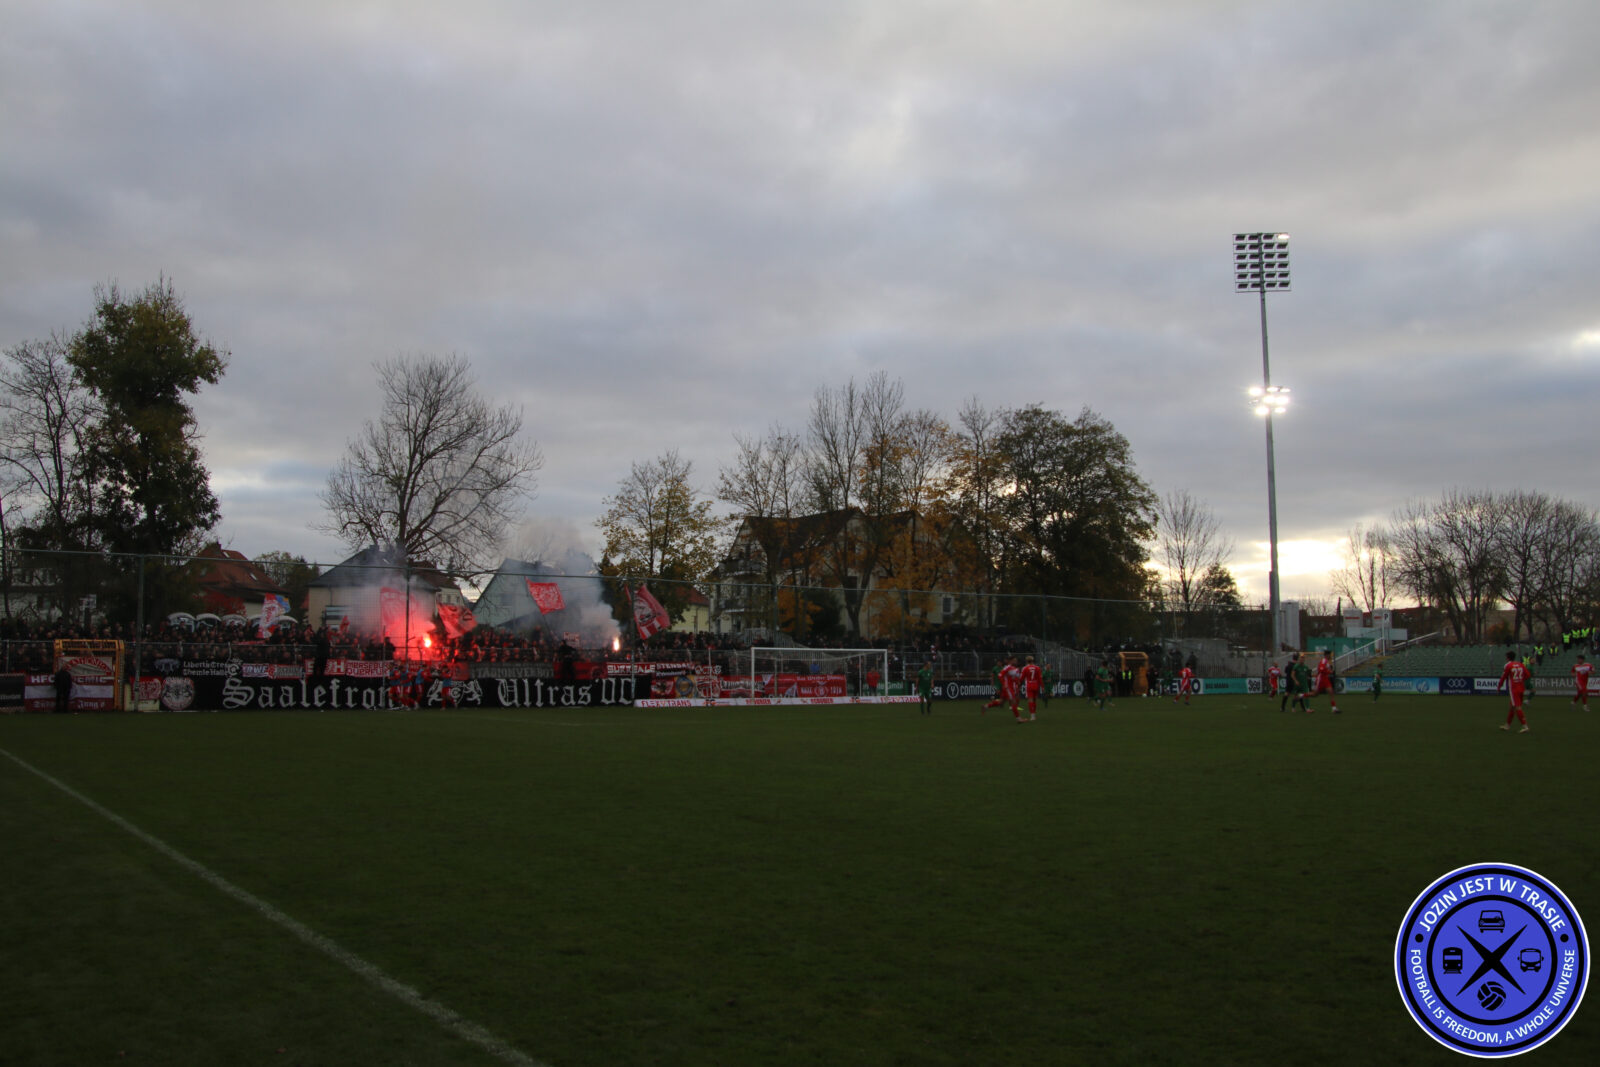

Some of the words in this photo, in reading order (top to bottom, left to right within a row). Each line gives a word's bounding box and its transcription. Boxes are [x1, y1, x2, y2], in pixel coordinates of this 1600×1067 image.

[31, 674, 56, 684] HFC
[1029, 667, 1037, 680] 7
[1511, 667, 1525, 680] 22
[222, 677, 395, 709] Saalefron
[496, 678, 592, 707] Ultras
[960, 684, 998, 696] communis
